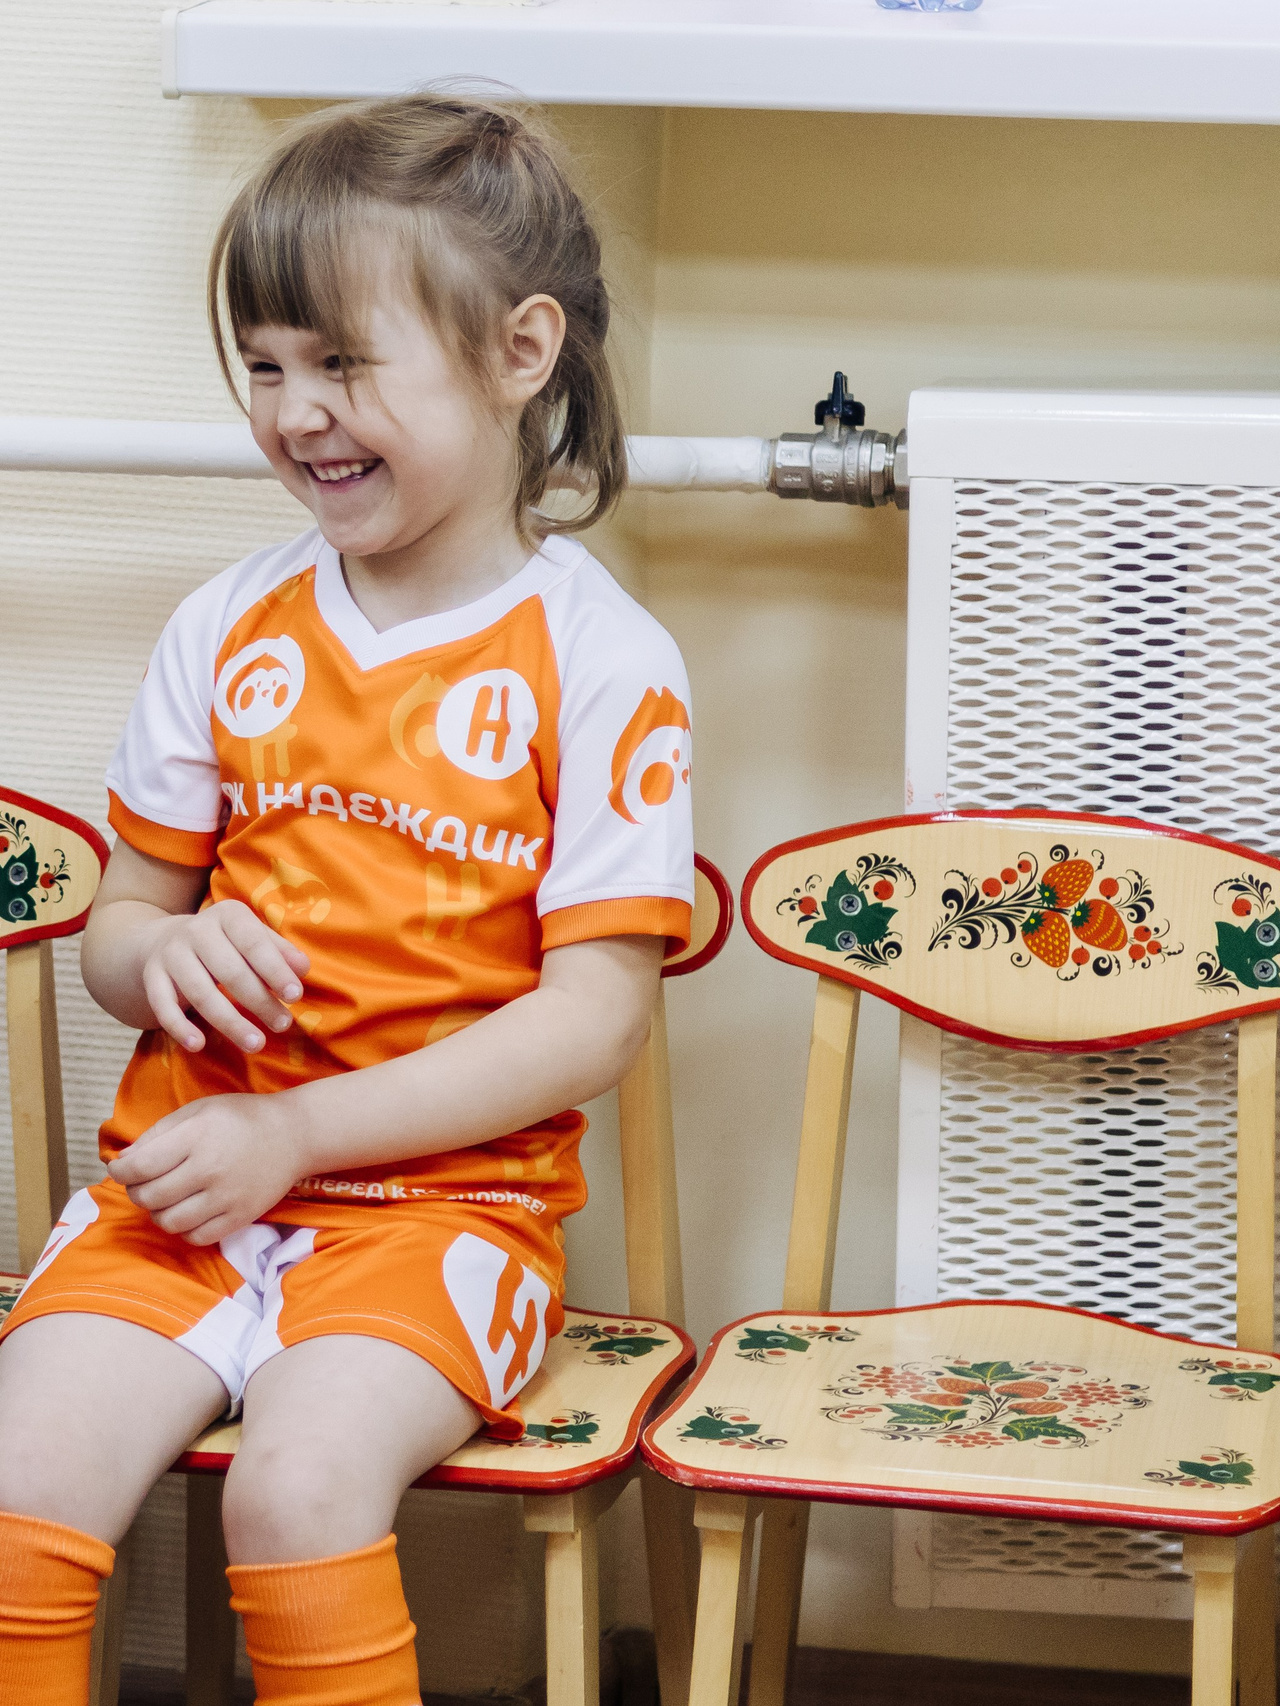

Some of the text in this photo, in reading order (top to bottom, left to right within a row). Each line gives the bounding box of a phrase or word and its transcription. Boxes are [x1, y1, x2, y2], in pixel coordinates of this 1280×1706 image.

[465, 685, 512, 764] Н
[256, 781, 546, 872] НАДЕЖДИК
[293, 1176, 386, 1201] ПЕРЕД
